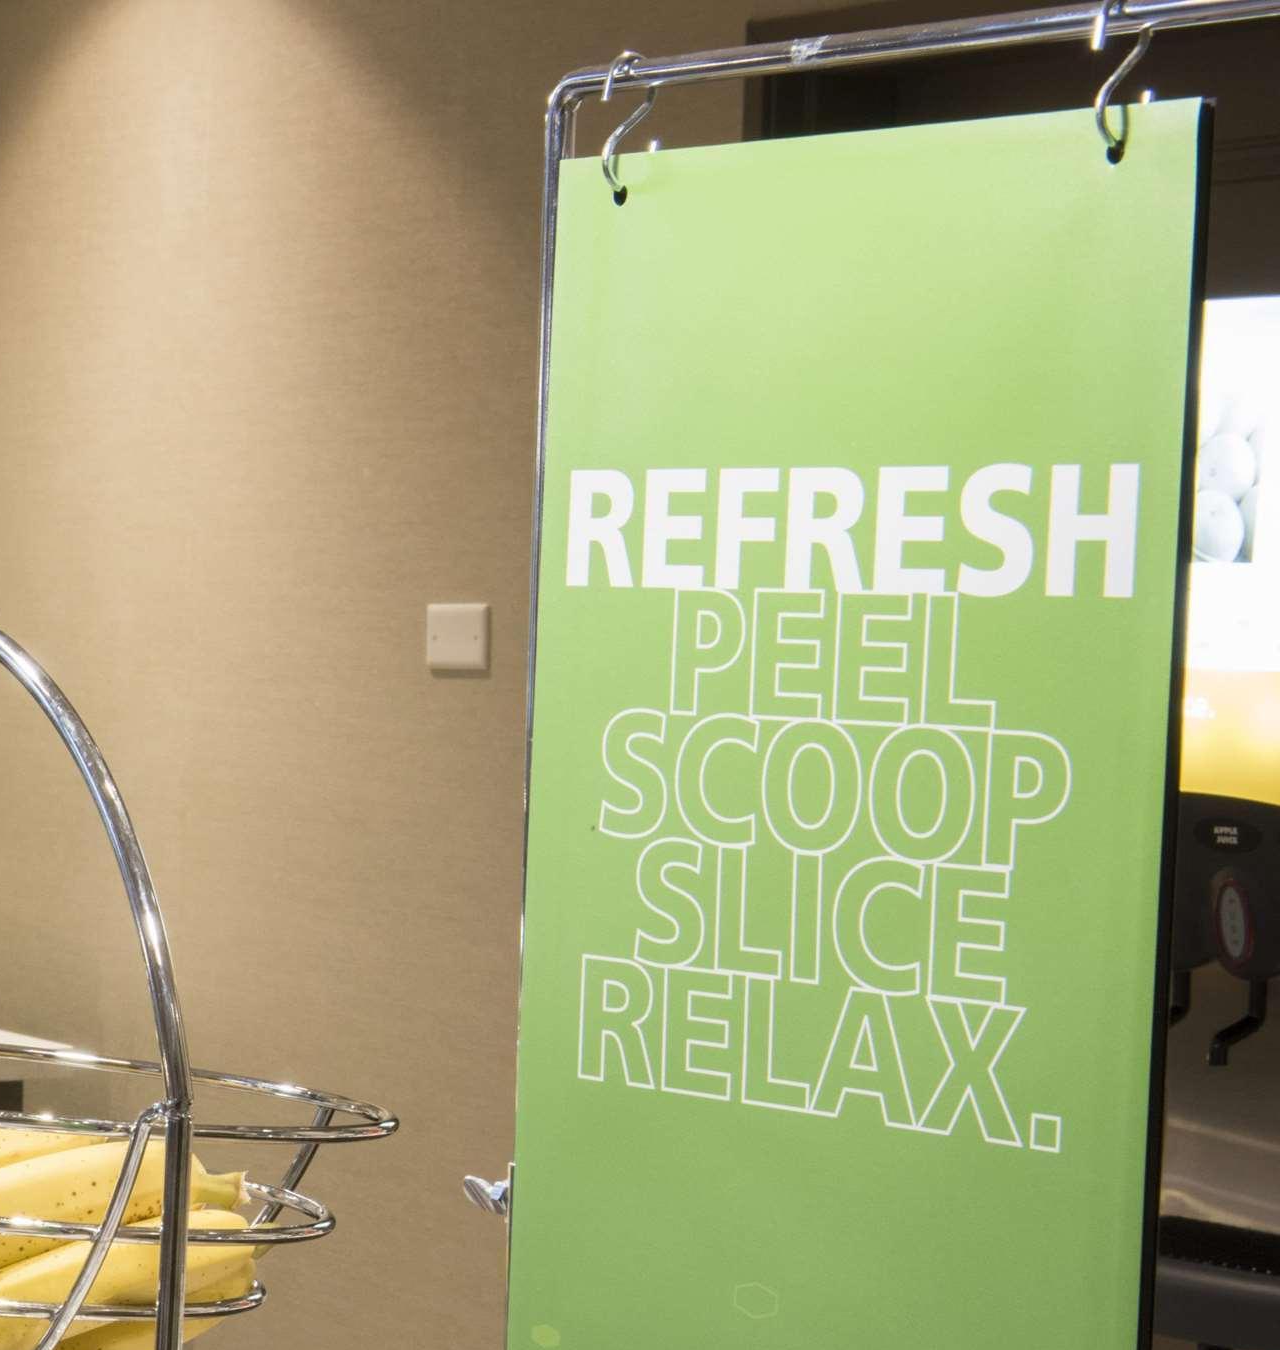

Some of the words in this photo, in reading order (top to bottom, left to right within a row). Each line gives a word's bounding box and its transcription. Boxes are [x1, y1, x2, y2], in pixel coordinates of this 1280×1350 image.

[565, 462, 1141, 598] REFRESH
[669, 587, 996, 730] PEEL
[599, 708, 1072, 869] SCOOP
[634, 837, 1010, 1005] SLICE
[578, 954, 1062, 1153] RELAX.
